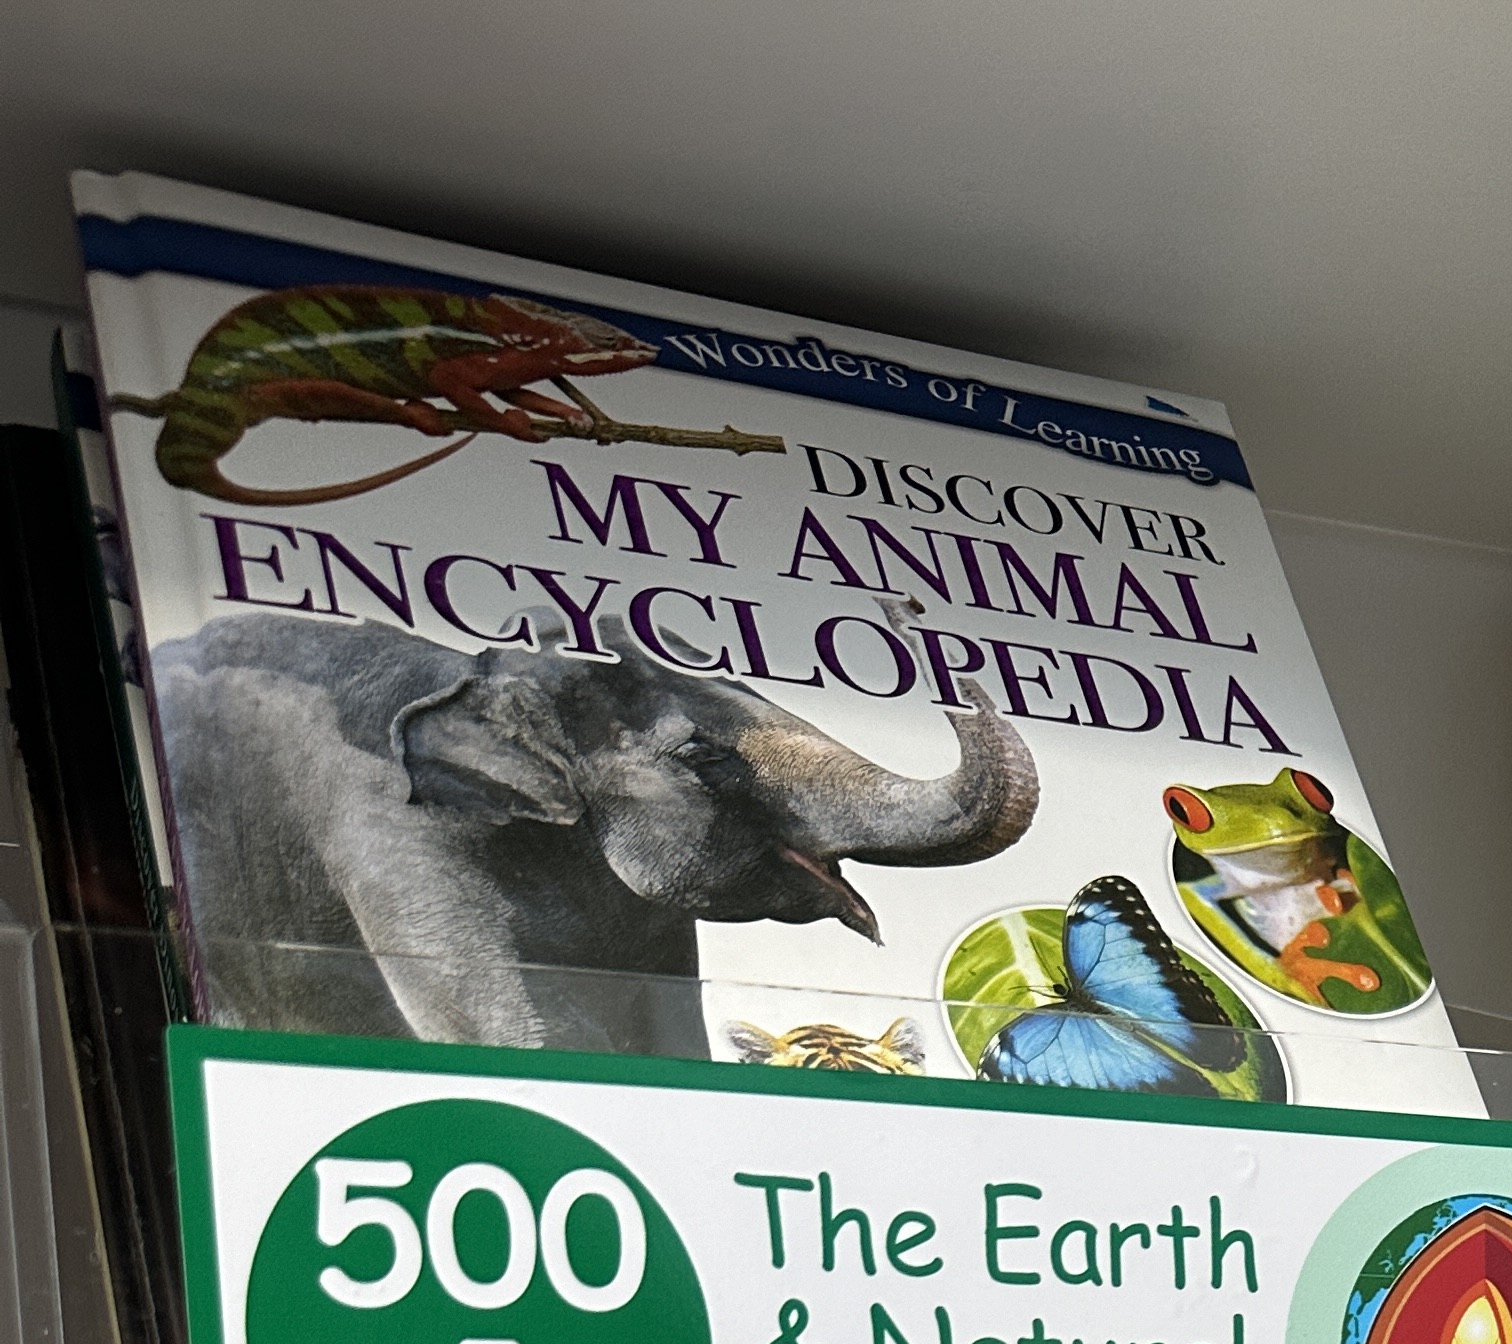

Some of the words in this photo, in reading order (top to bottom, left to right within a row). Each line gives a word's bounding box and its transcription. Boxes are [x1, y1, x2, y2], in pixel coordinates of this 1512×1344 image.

[664, 332, 908, 390] Wonders
[927, 376, 987, 413] of
[998, 397, 1215, 484] Learning
[530, 459, 742, 569] MY
[779, 505, 1259, 654] ANIMAL
[796, 442, 1226, 566] DISCOVER
[200, 513, 1303, 758] ENCYCLOPEDIA
[315, 1158, 648, 1313] 500
[734, 1171, 943, 1278] The
[983, 1181, 1259, 1294] Earth
